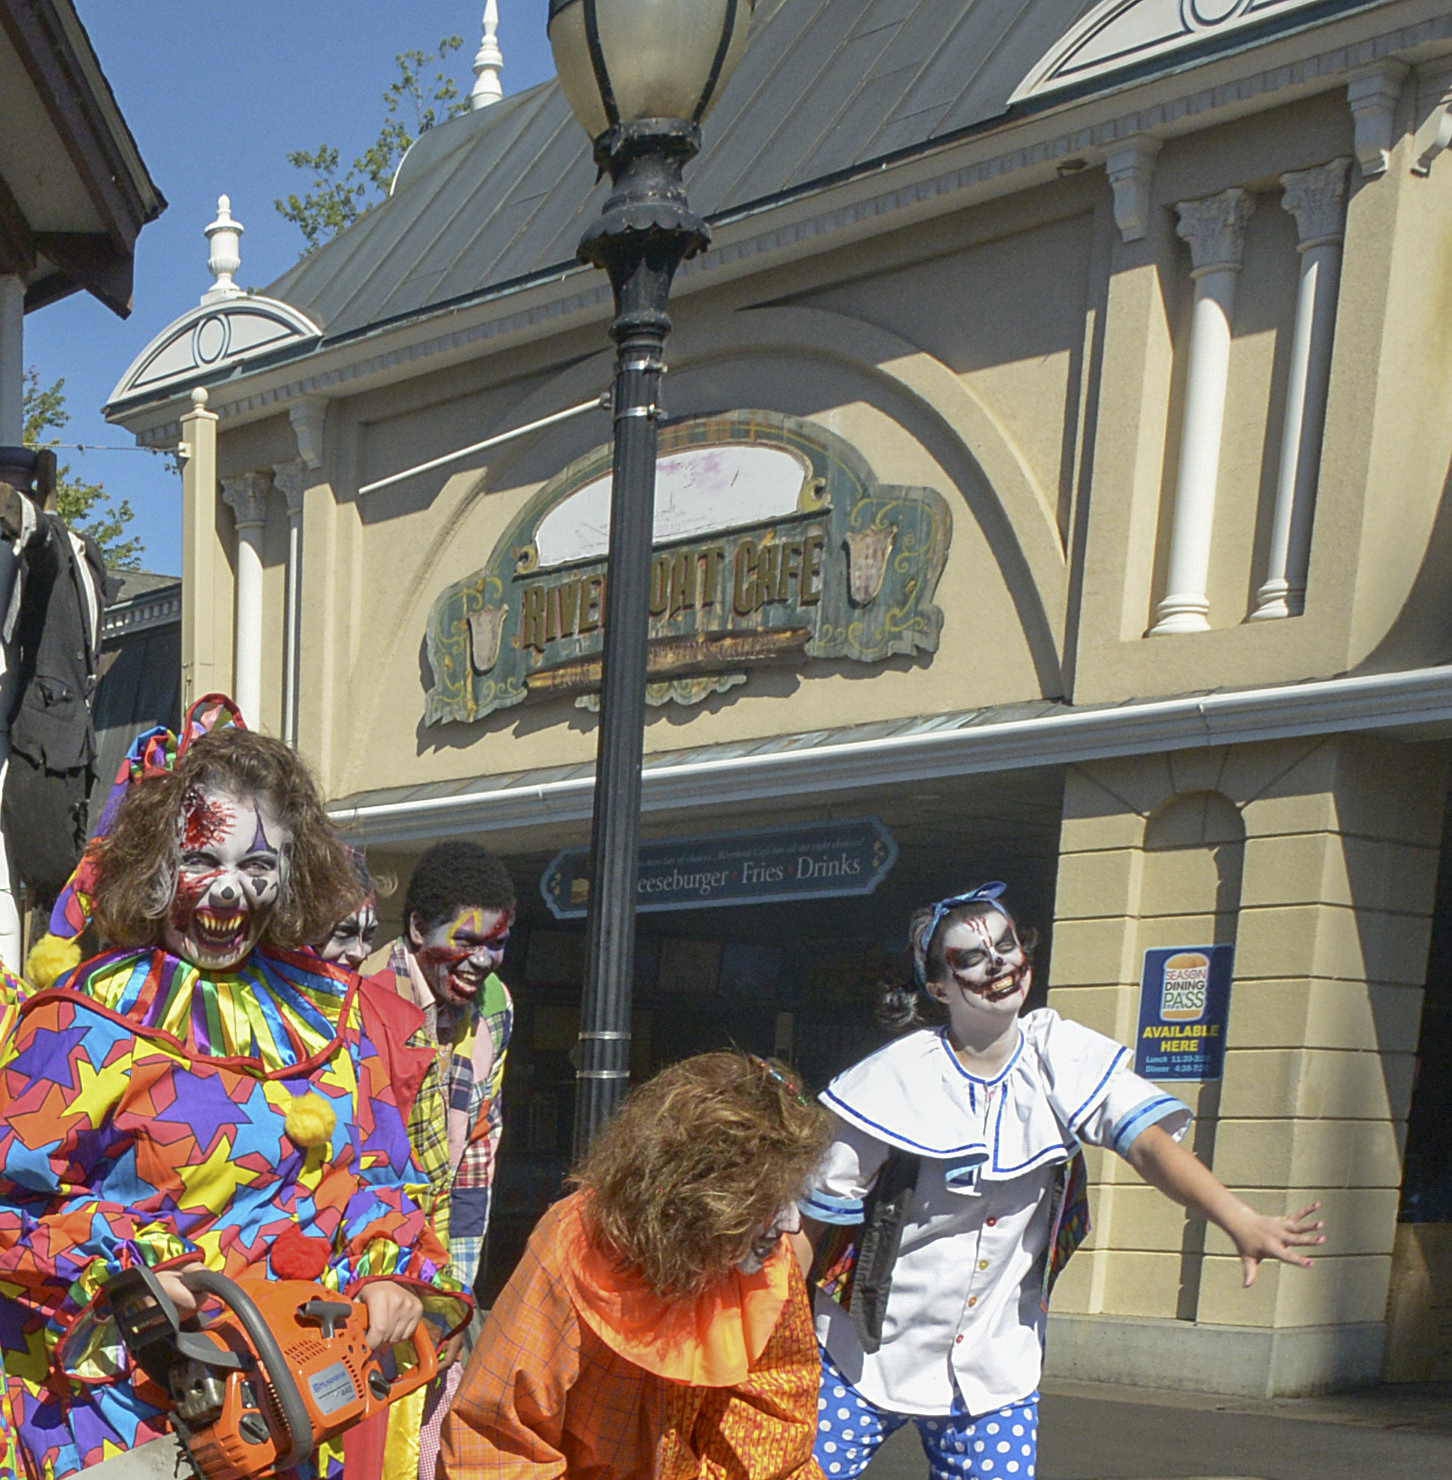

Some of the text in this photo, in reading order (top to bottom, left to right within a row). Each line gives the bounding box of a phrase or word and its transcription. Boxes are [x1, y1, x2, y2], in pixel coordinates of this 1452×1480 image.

[521, 546, 725, 654] RIVEOAT
[637, 853, 862, 897] eeseburger Fries Drinks
[1166, 969, 1207, 980] SEASON
[1165, 980, 1205, 991] DINING
[1163, 991, 1204, 1009] PASS
[1143, 1025, 1220, 1038] AVAILABLE
[1160, 1039, 1200, 1052] HERE
